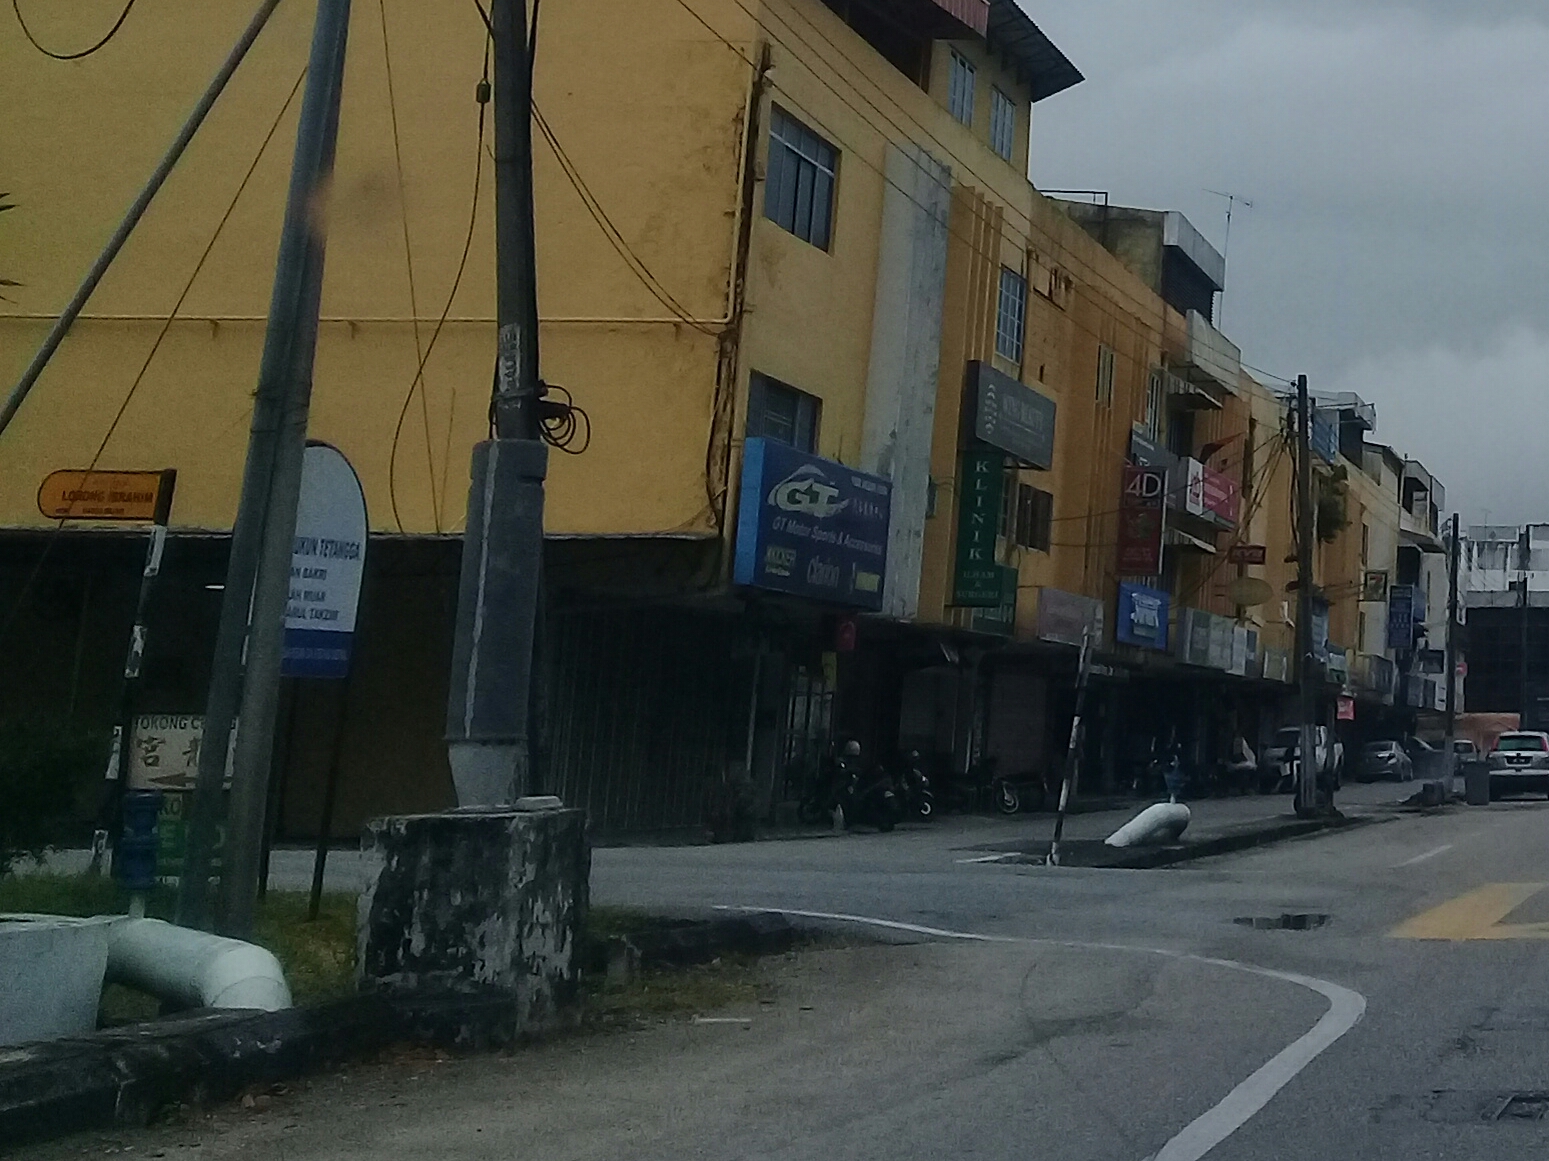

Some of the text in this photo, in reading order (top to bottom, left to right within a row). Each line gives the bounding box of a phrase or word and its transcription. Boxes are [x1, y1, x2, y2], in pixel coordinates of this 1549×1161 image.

[1124, 473, 1161, 497] 4D
[61, 490, 105, 502] LORONG
[776, 478, 840, 517] GT
[968, 460, 990, 561] KLINIK
[772, 516, 785, 530] GT
[293, 537, 317, 555] UKUN
